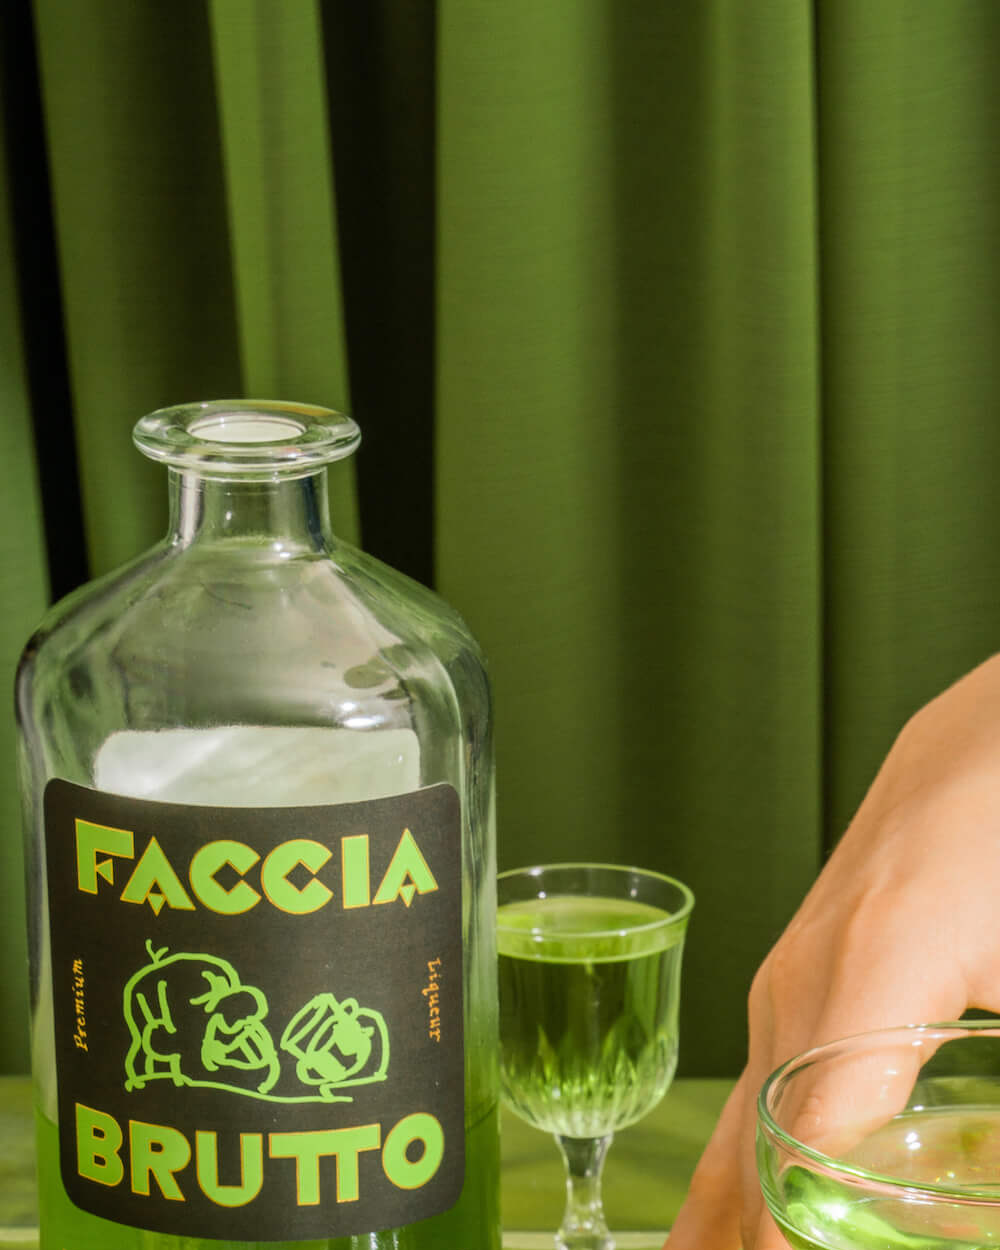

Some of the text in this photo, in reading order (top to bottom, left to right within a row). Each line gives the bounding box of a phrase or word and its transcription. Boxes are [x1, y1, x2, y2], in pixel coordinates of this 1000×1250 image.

[75, 818, 439, 916] FACCIA
[72, 957, 89, 1053] Premium
[421, 957, 441, 1043] Liqueur
[75, 1102, 444, 1208] BRUTTO
